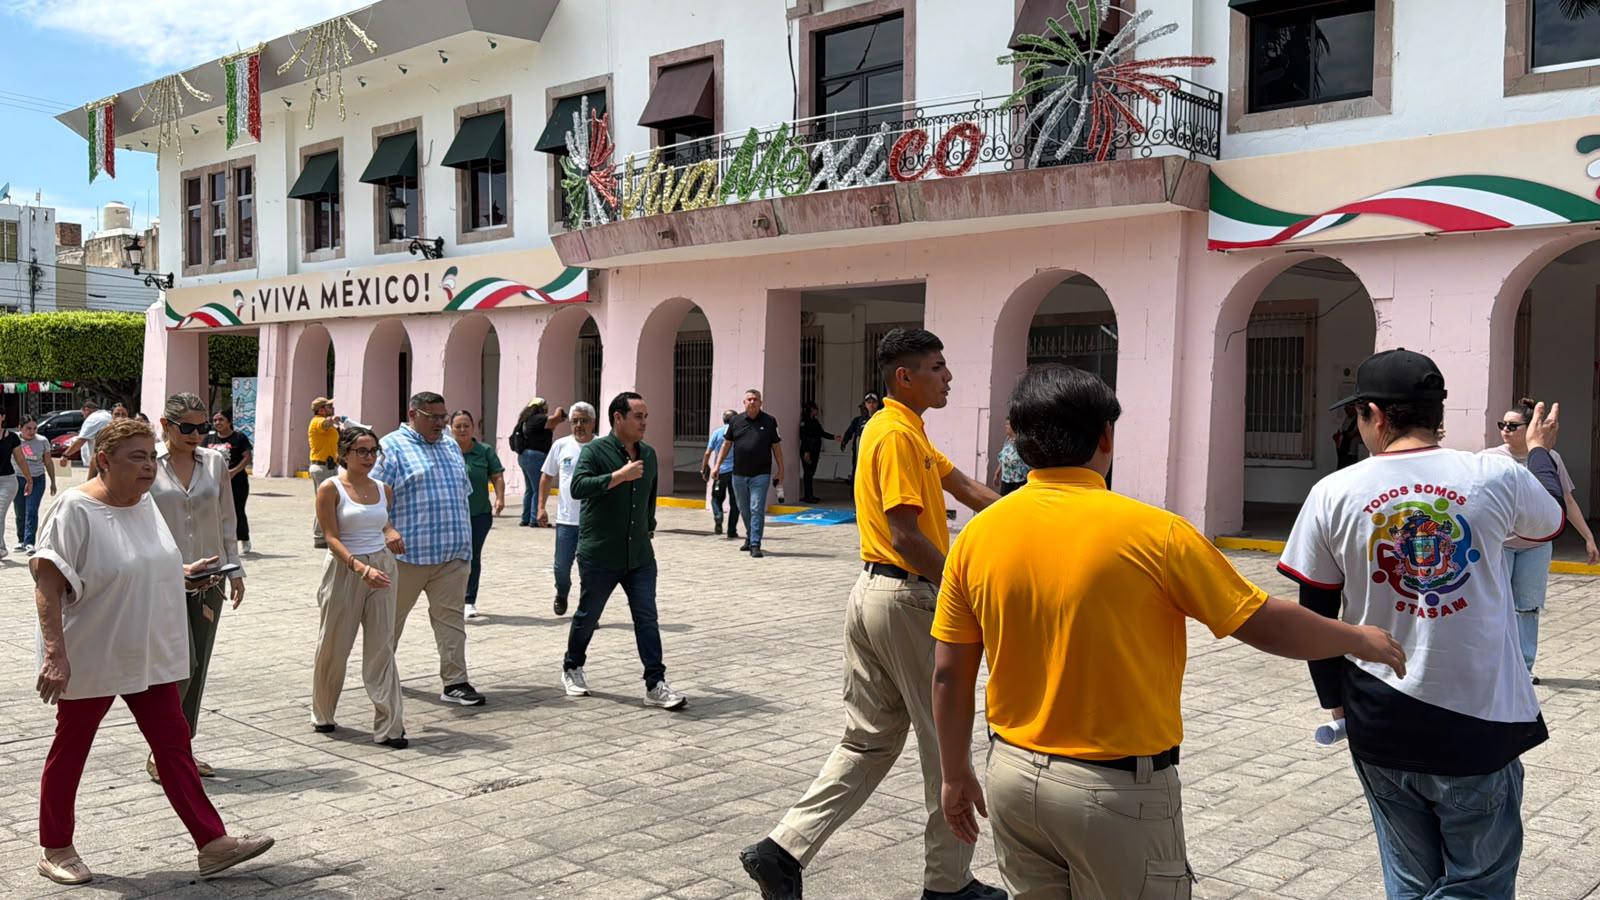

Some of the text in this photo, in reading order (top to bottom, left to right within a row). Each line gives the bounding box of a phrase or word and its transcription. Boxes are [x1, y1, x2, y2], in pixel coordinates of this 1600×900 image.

[251, 270, 430, 321] ¡VIVA MÉXICO!
[1363, 484, 1467, 514] TODOS SOMOS
[1395, 597, 1468, 618] STASAM
